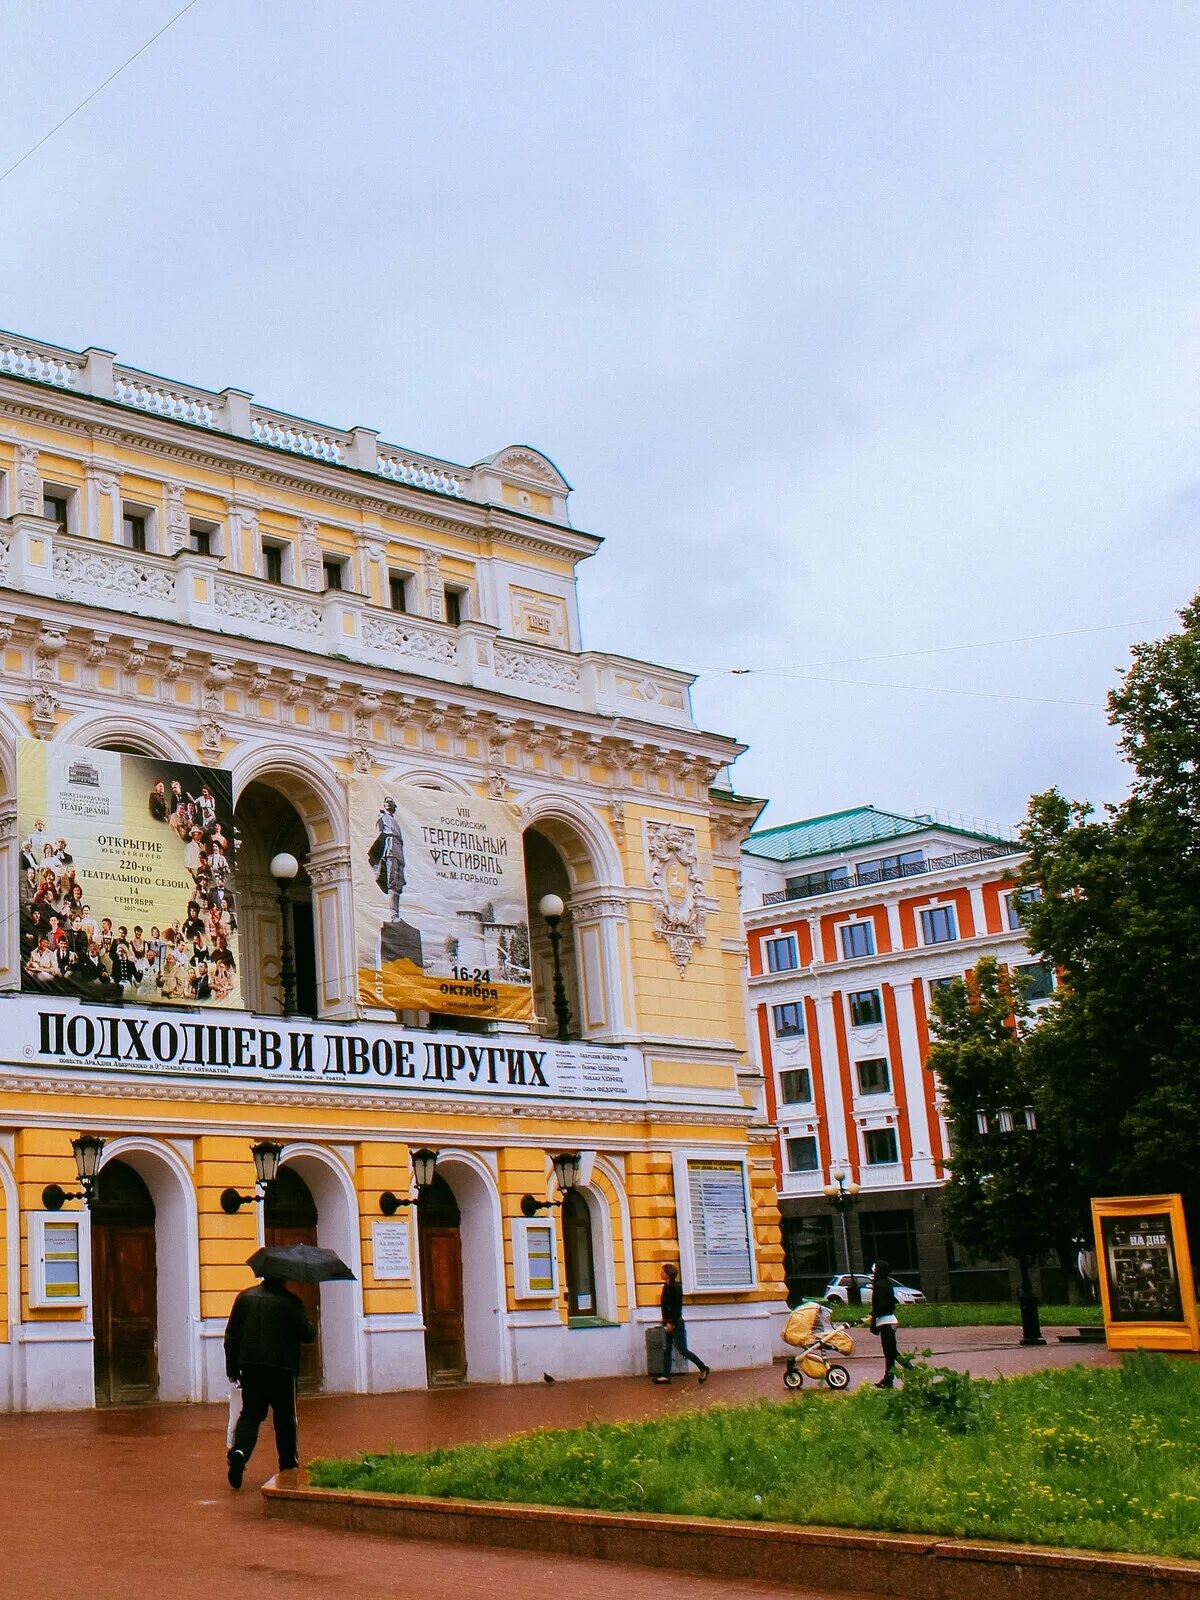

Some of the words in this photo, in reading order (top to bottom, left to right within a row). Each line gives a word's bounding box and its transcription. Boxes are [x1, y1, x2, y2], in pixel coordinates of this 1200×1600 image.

[61, 803, 82, 812] ТЕАТР
[84, 806, 110, 816] ДРАМЫ
[456, 807, 470, 818] VIII
[440, 816, 487, 831] РОССИЙСКИЙ
[98, 835, 163, 852] ОТКРЫТИЕ
[420, 826, 508, 856] ТЕАТРАЛЬНЫЙ
[101, 848, 162, 859] ЮБИЛЕЙНОГО
[120, 859, 153, 873] 220-го
[429, 848, 503, 874] ФЕСТИВАЛЬ
[82, 869, 151, 885] ТЕАТРАЛЬНОГО
[155, 878, 190, 889] СЕЗОНА
[460, 872, 498, 886] ГОРЬКОГО
[129, 887, 139, 895] 14
[114, 896, 154, 906] СЕНТЯБРЯ
[451, 965, 491, 983] 16-24
[440, 983, 498, 1001] октября
[38, 1012, 283, 1069] ПОДХОДЦЕВ
[288, 1032, 315, 1072] И
[322, 1034, 415, 1078] ДВОЕ
[422, 1042, 550, 1087] ДРУГИХ
[1130, 1235, 1145, 1246] НА
[1146, 1234, 1167, 1247] ДНЕ
